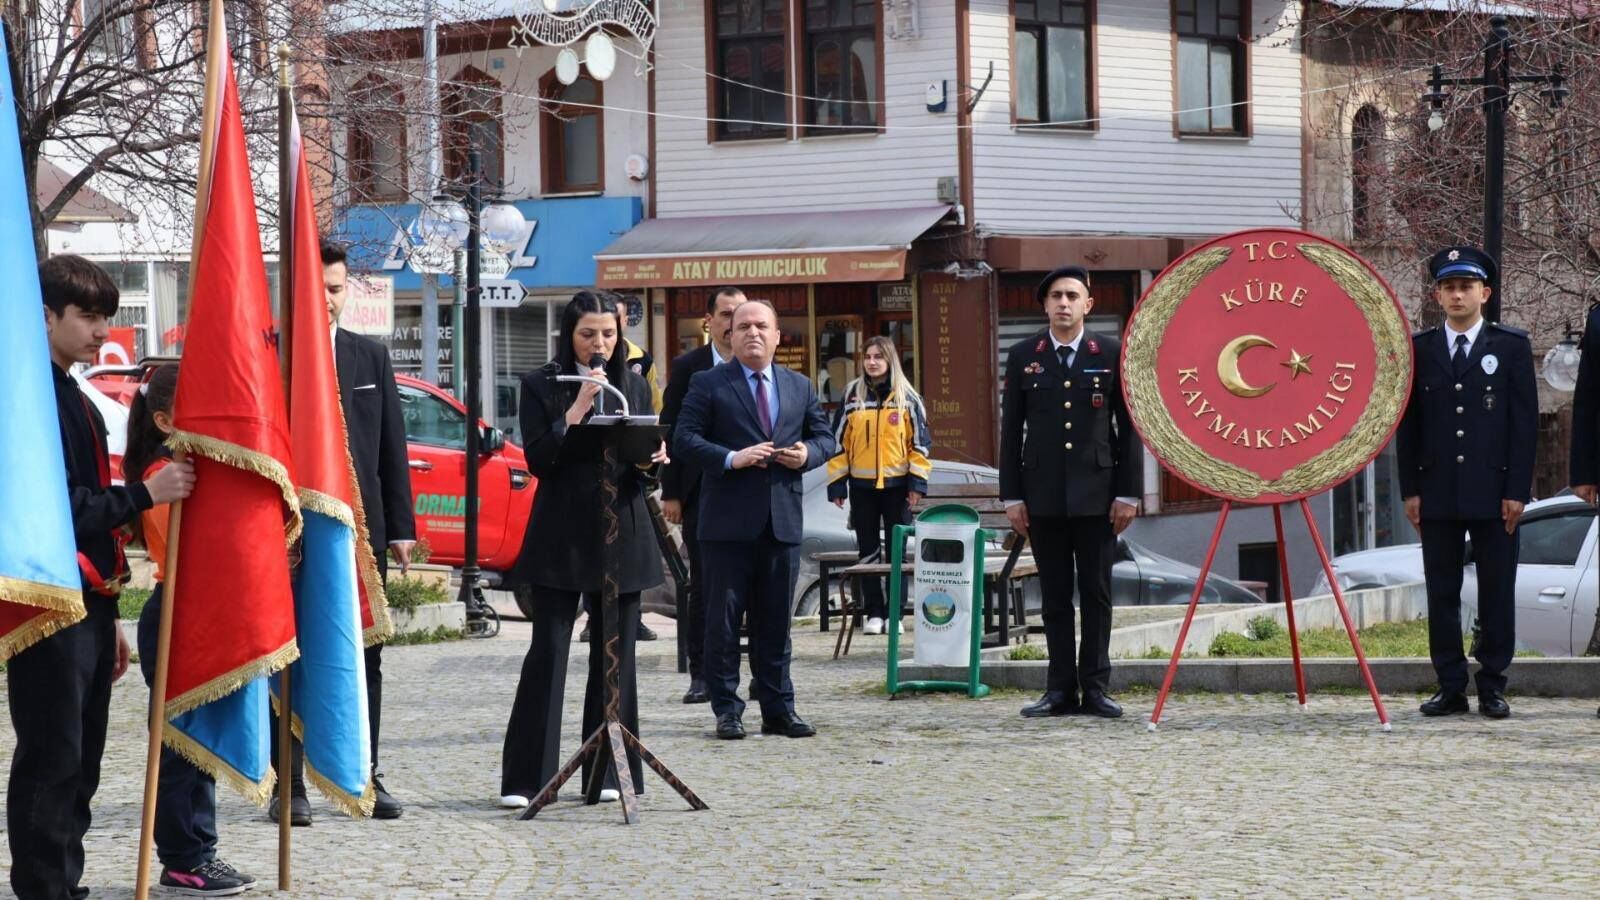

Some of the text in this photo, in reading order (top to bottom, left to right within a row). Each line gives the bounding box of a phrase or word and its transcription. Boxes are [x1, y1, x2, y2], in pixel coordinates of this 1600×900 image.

[1243, 241, 1295, 261] T.C.
[673, 261, 711, 280] ATAY
[716, 256, 828, 278] KUYUMCULUK
[1220, 279, 1308, 311] KÜRE
[1178, 361, 1356, 449] KAYMAKAMLIĞI
[415, 493, 481, 517] ORMA
